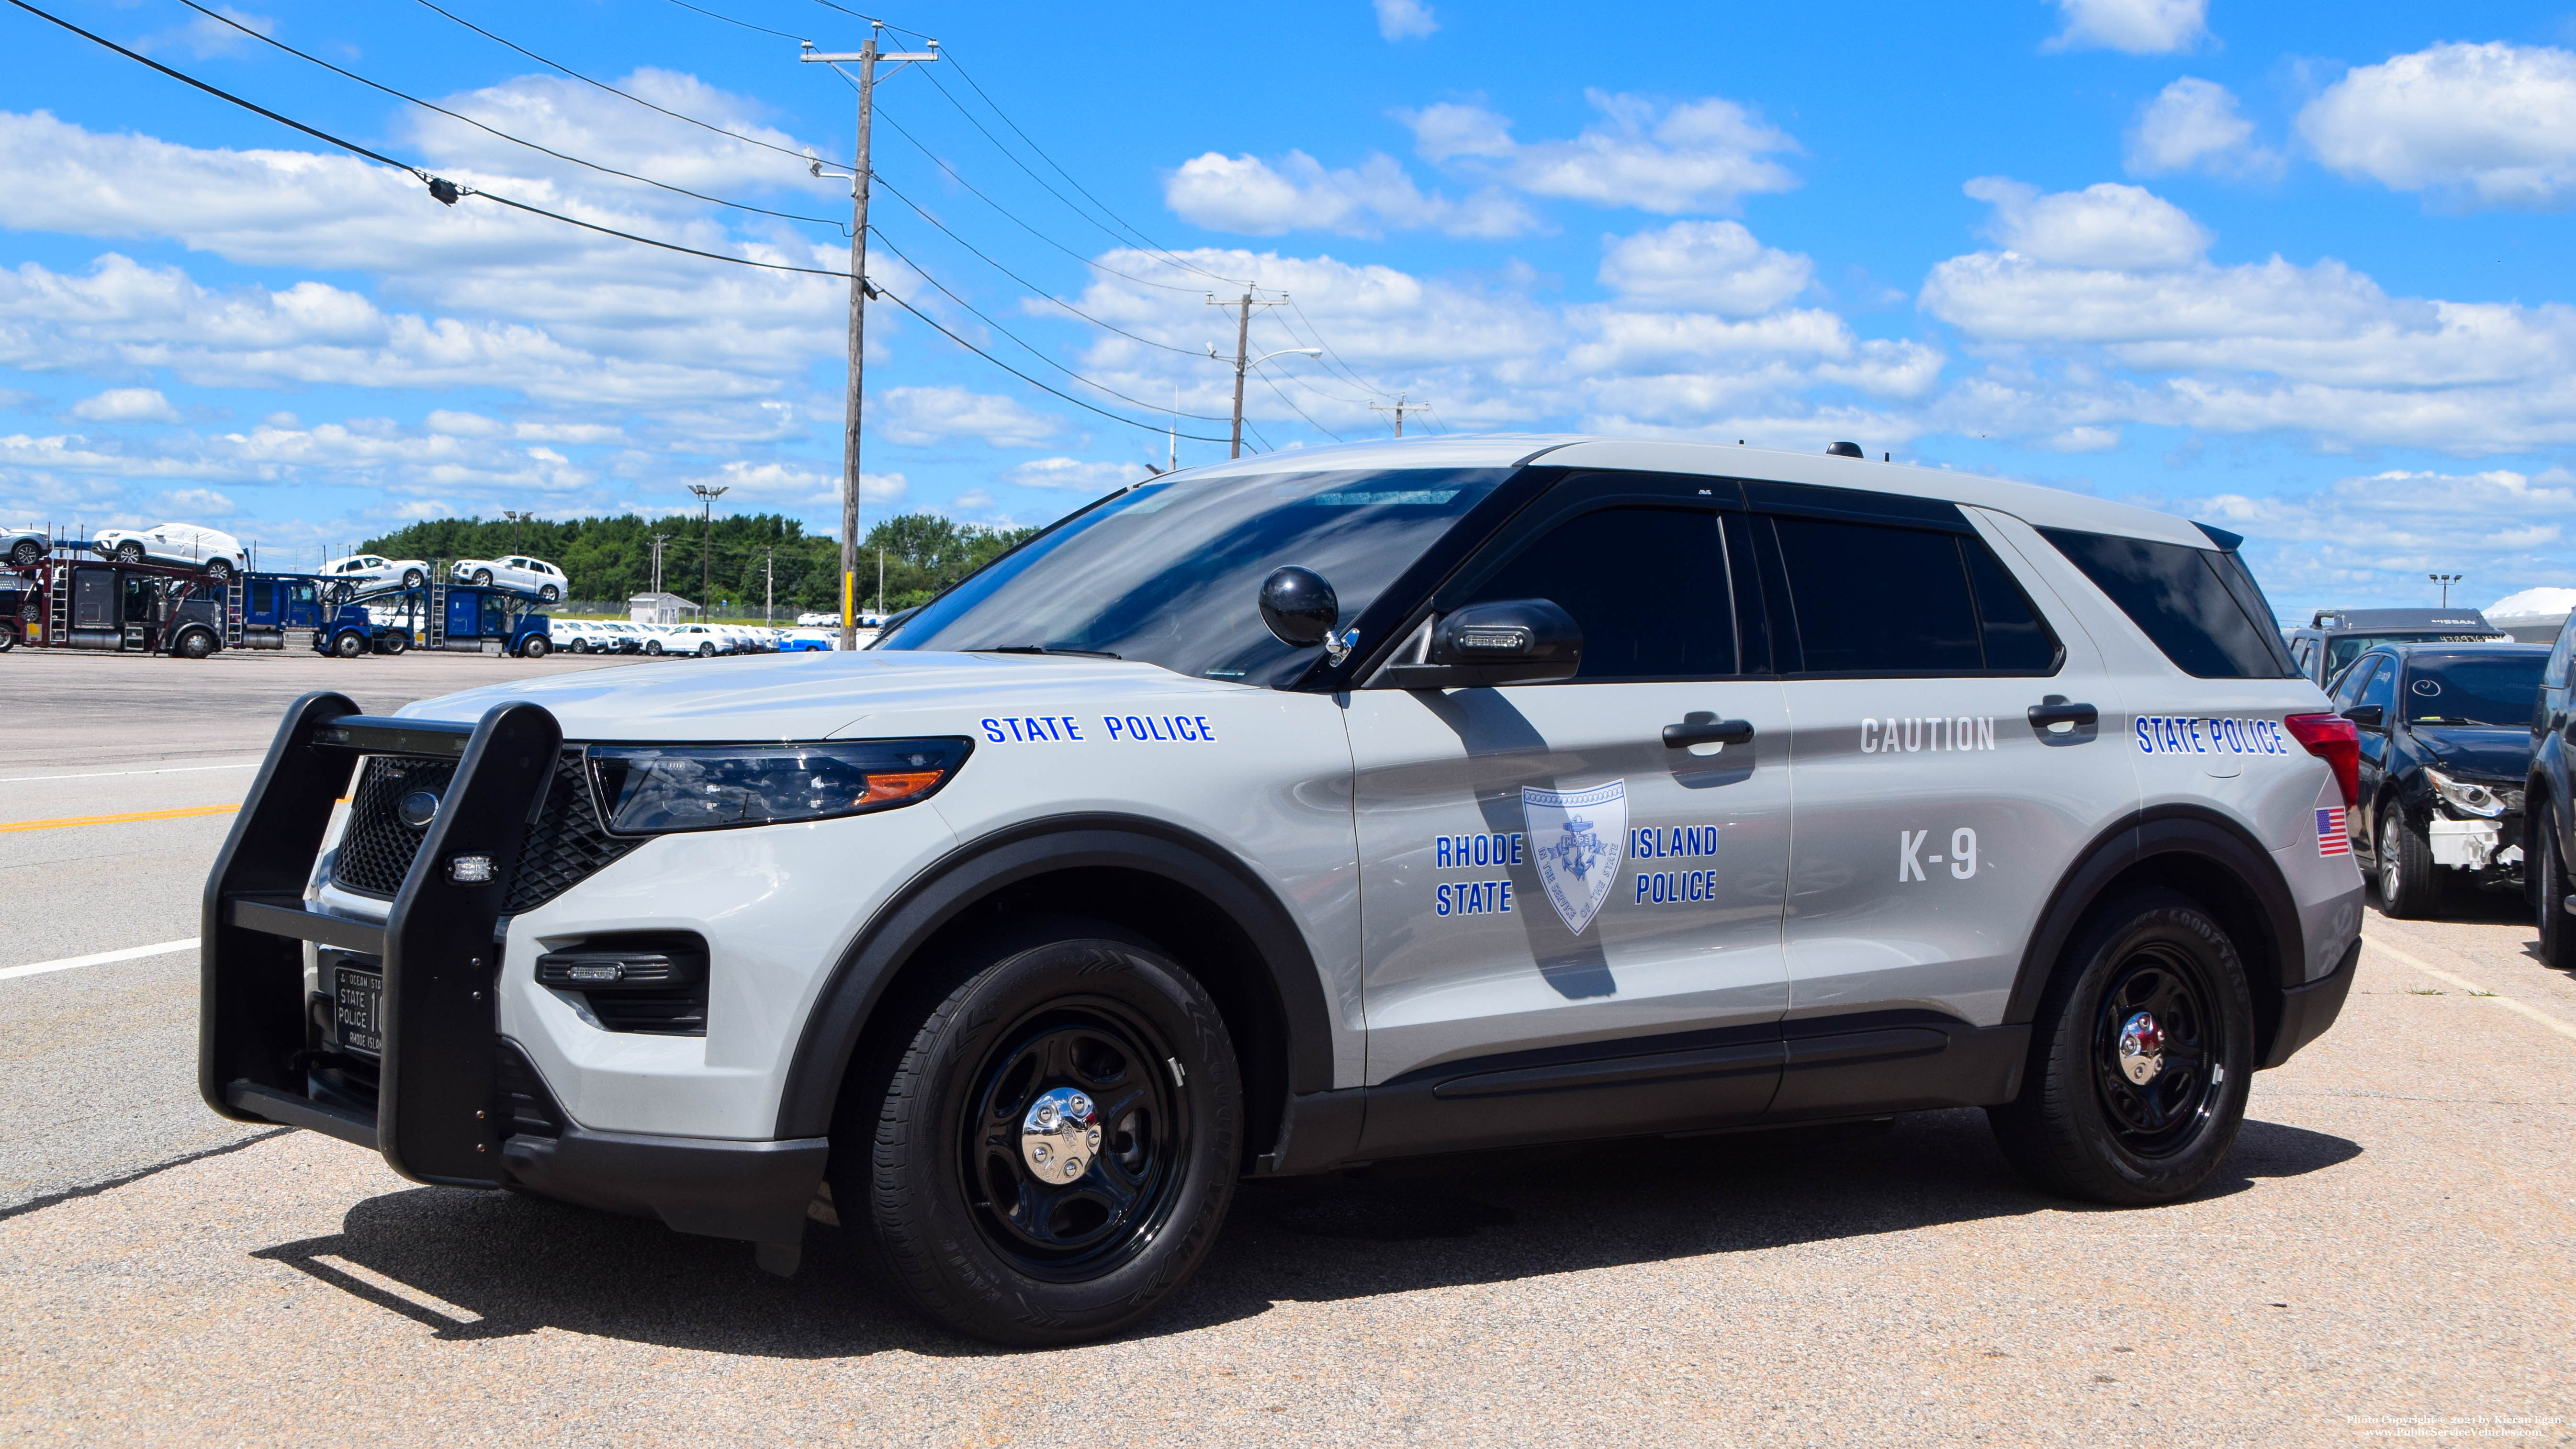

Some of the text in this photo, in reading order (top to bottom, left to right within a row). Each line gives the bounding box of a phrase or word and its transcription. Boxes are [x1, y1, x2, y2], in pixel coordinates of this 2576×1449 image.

[980, 715, 1218, 743] STATE POLICE
[1861, 717, 1995, 753] CAUTION
[2136, 715, 2289, 756] STATE POLICE
[1436, 825, 1718, 868] RHODE ISLAND
[1566, 836, 1590, 844] HOPE
[1898, 827, 1977, 883] K-9
[1436, 869, 1717, 917] STATE POLICE
[1538, 843, 1619, 920] IN THE SERVICE OF THE STATE
[349, 974, 382, 989] OCEAN STA
[340, 988, 365, 1008] STATE
[339, 1007, 367, 1028] POLICE
[349, 1032, 366, 1047] RHODE
